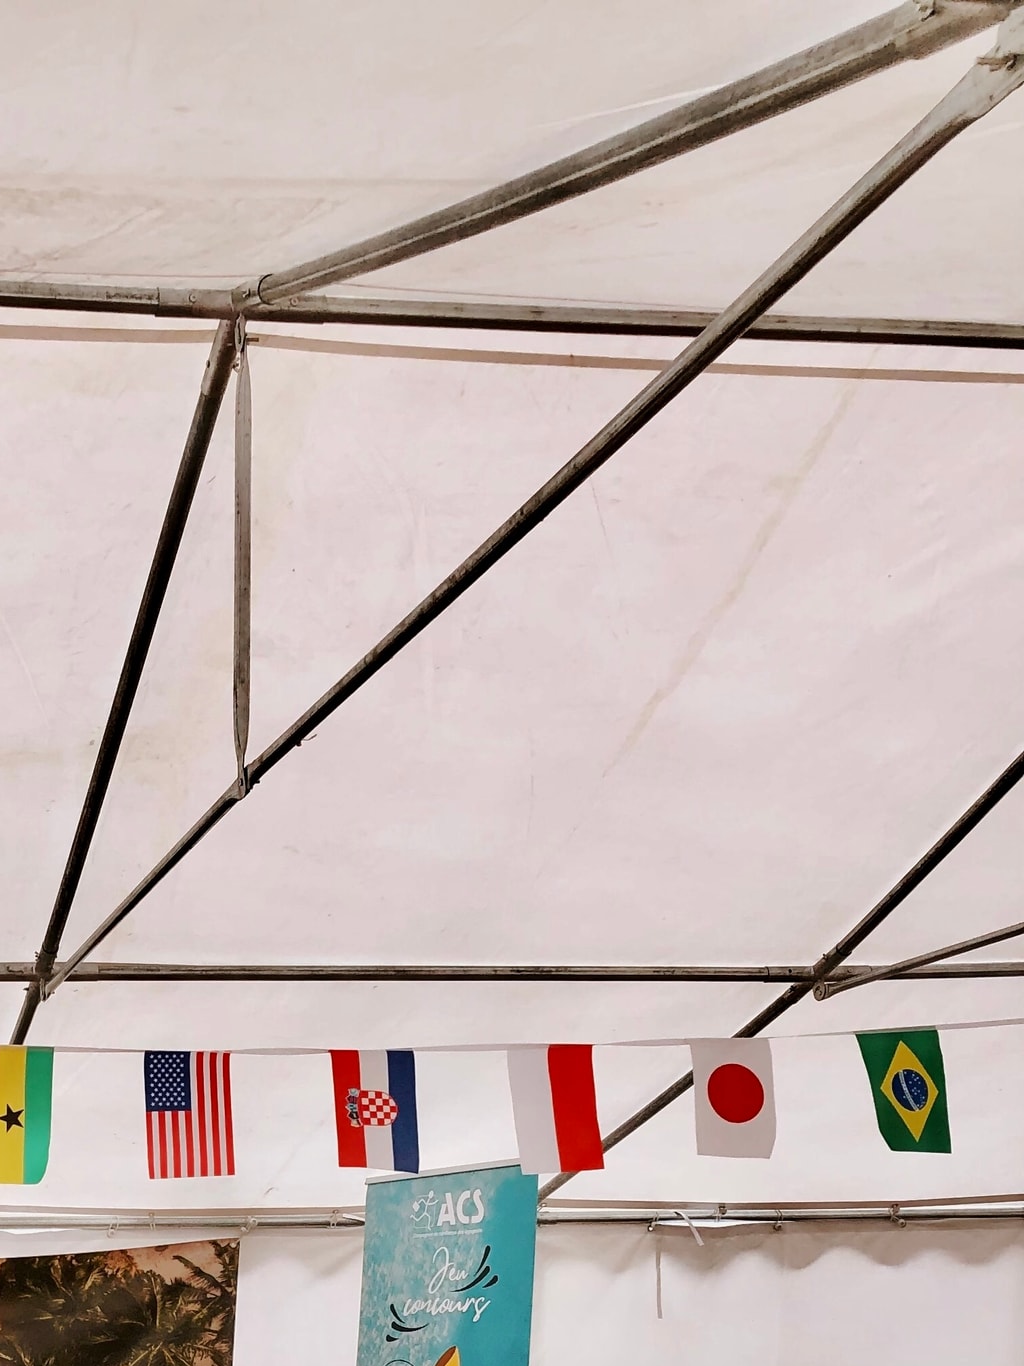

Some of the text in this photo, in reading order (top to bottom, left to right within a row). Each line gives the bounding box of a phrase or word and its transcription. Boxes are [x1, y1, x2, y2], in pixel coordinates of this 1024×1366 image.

[436, 1189, 485, 1227] ACS
[428, 1246, 469, 1295] Jeu
[403, 1296, 491, 1323] concours
